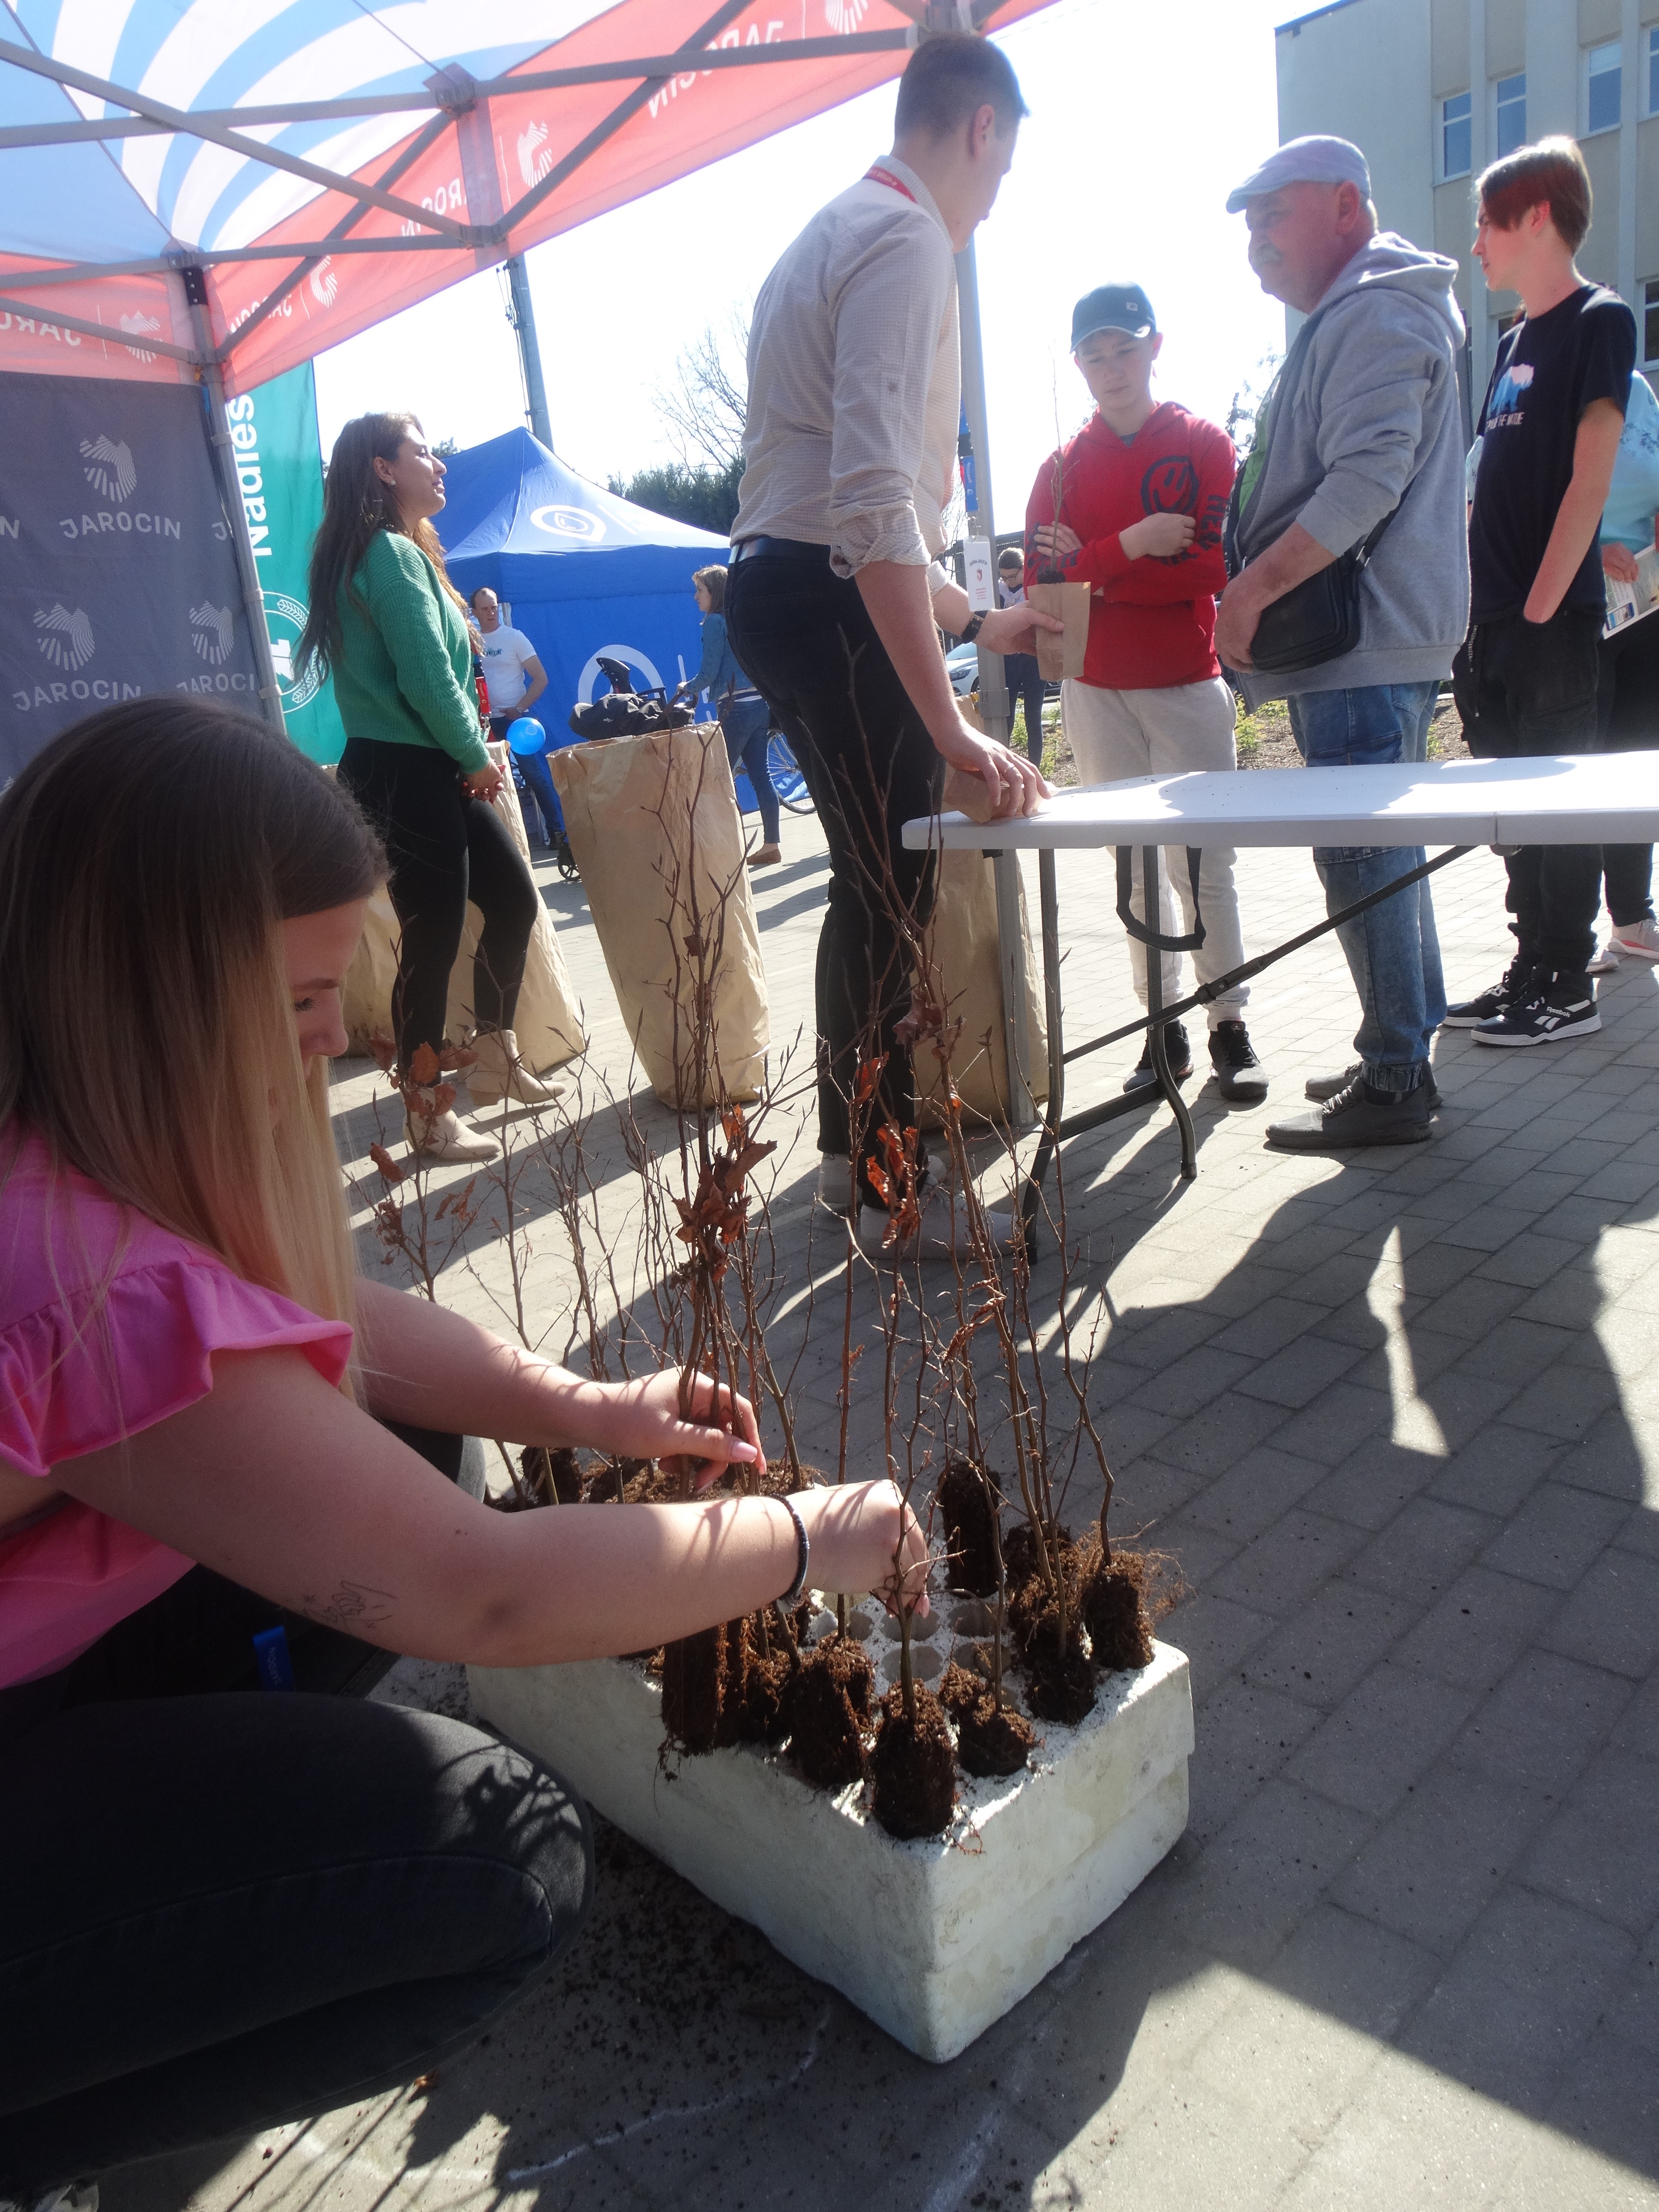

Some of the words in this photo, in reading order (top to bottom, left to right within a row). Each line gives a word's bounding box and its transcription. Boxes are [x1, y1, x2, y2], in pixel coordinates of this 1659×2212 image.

[59, 512, 180, 539] JAROCIN
[13, 680, 141, 711] JAROCIN
[1546, 1006, 1571, 1018] Reebok
